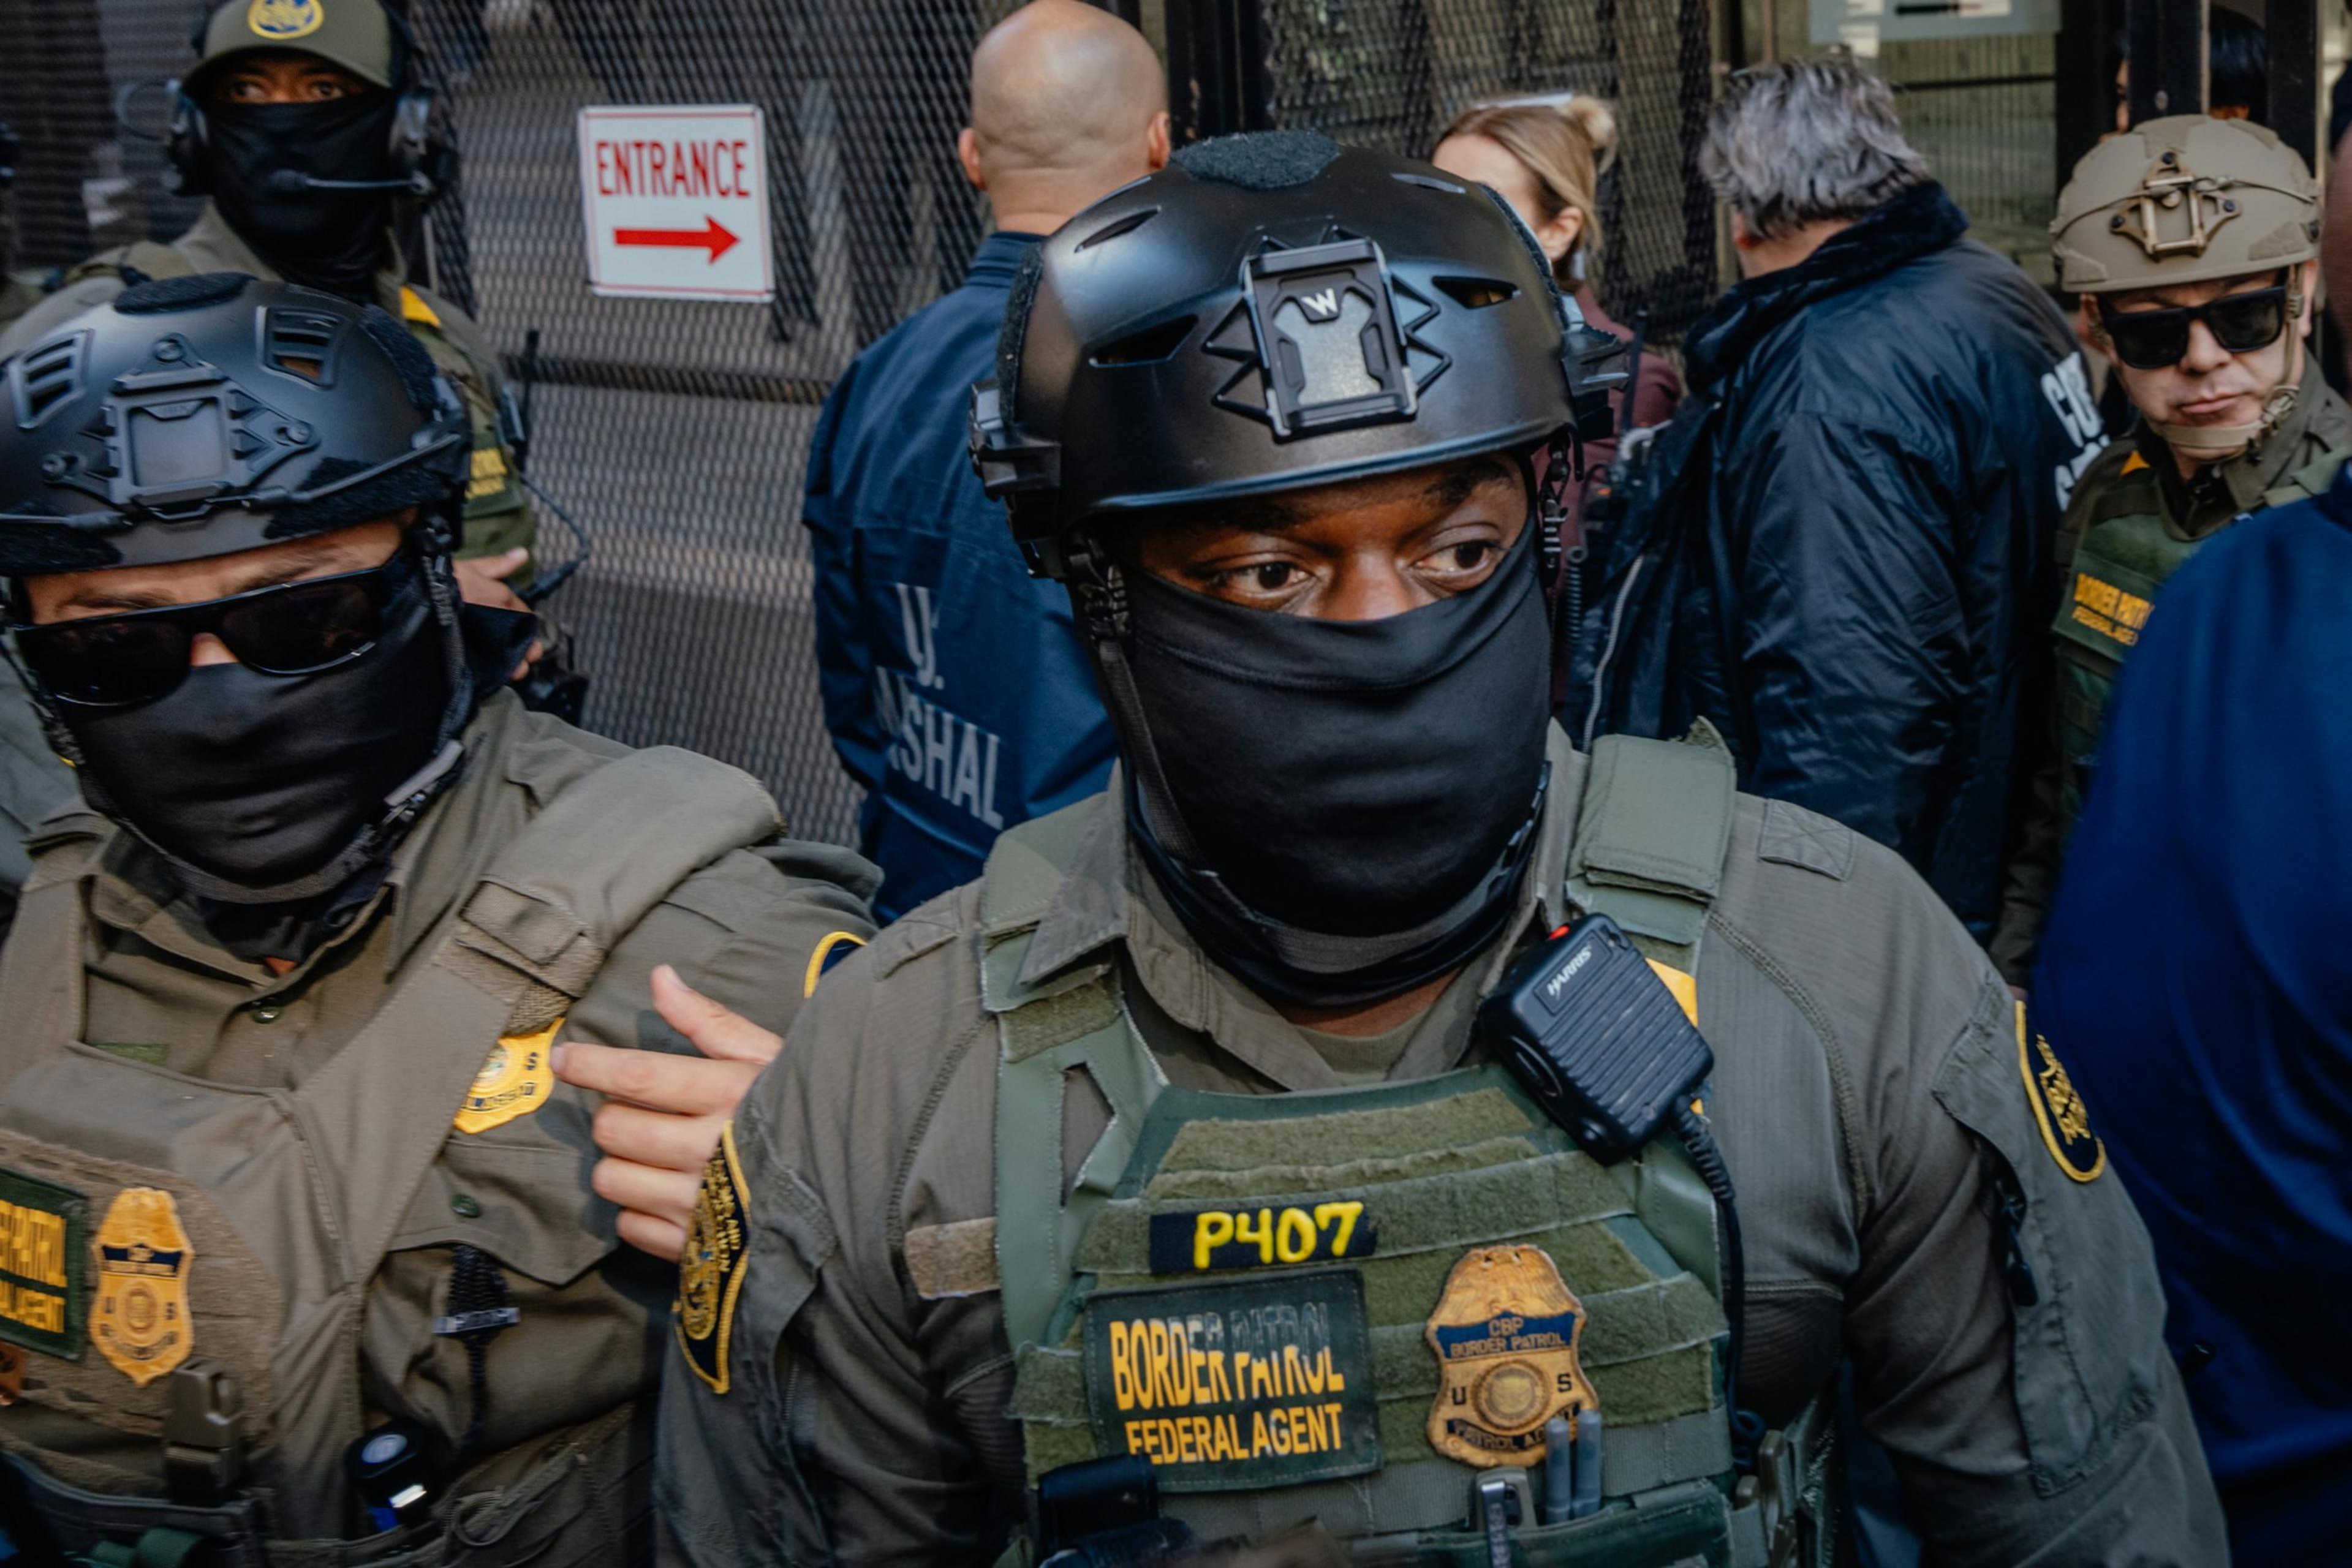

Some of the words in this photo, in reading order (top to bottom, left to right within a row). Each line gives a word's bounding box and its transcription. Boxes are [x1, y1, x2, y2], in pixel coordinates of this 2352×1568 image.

[596, 140, 751, 198] ENTRANCE
[1547, 944, 1591, 1000] HARRIS
[1193, 1201, 1364, 1269] P407
[1450, 1336, 1507, 1357] BORDER
[1510, 1333, 1565, 1352] PATROL
[1488, 1317, 1524, 1336] CBP
[1110, 1312, 1232, 1411] BORDER
[1452, 1387, 1467, 1405] U
[1557, 1373, 1572, 1392] S
[1125, 1414, 1249, 1465] FEDERAL
[1252, 1403, 1342, 1458] AGENT
